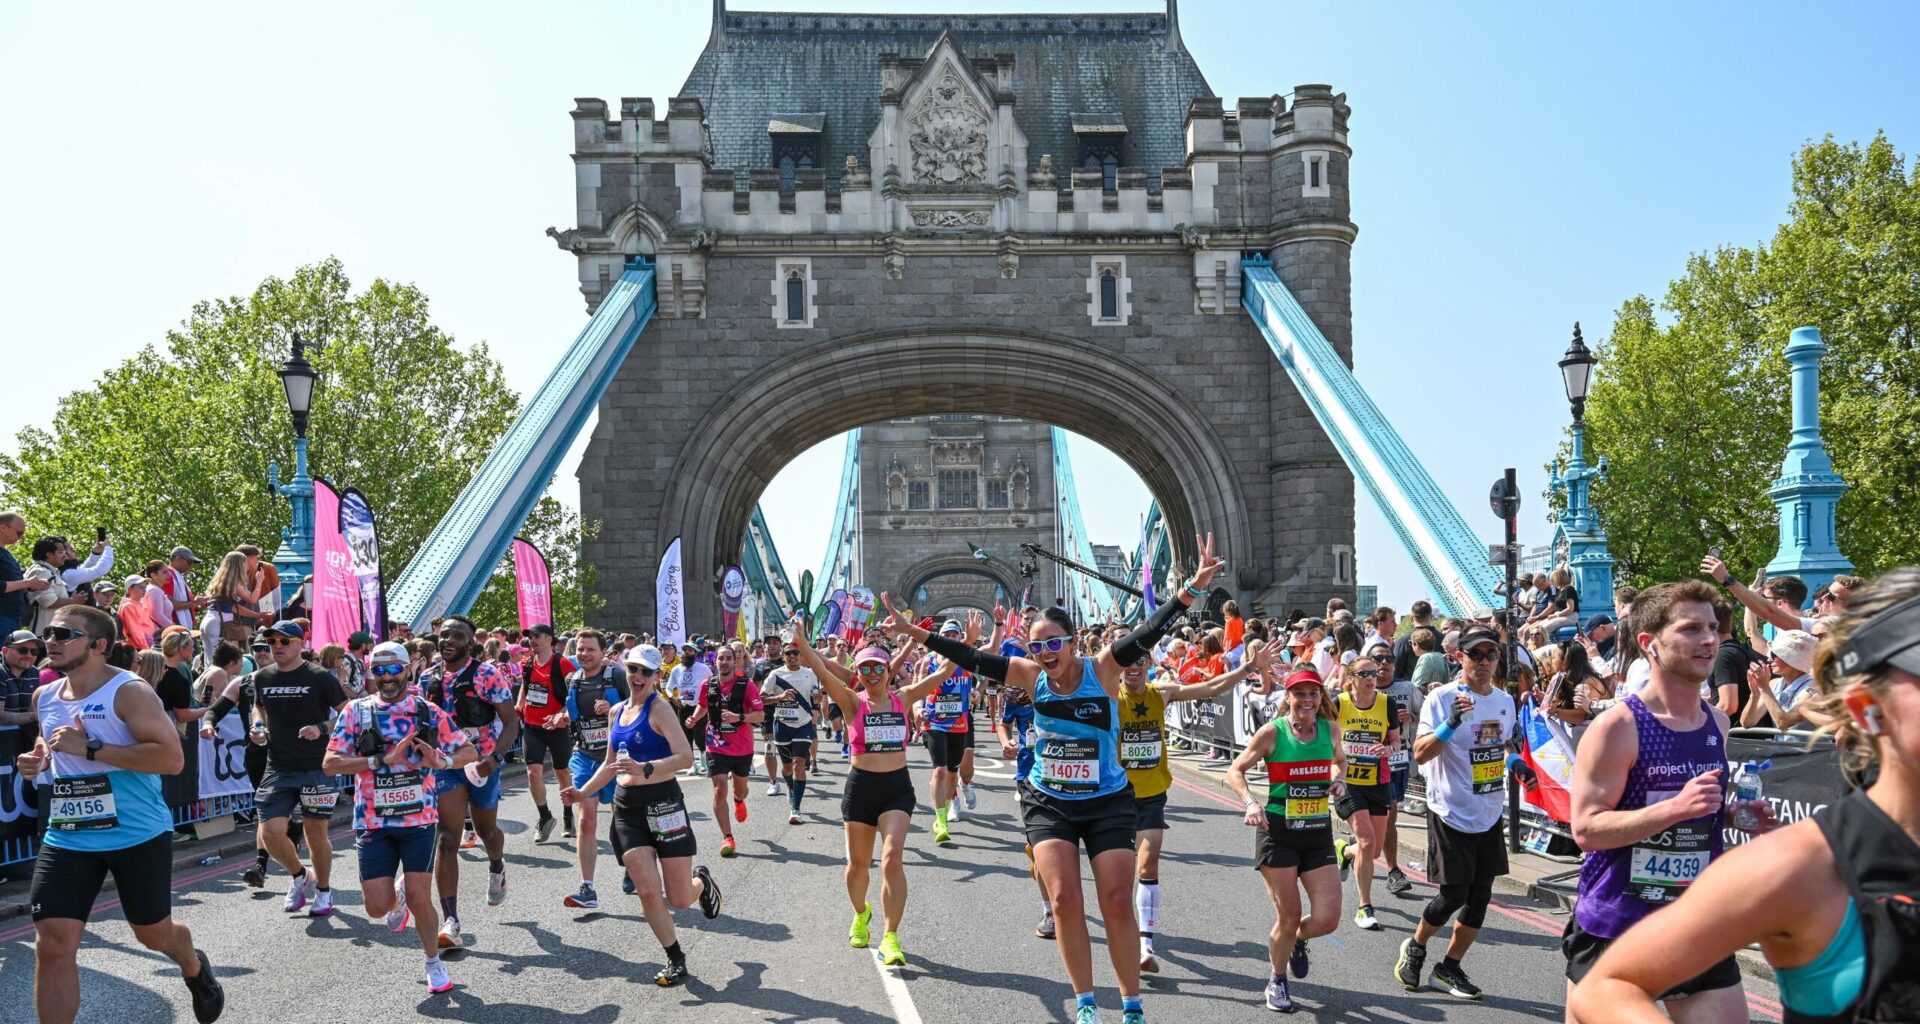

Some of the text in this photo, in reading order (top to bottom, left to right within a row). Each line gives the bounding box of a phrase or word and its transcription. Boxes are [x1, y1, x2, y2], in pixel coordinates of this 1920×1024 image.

[664, 564, 681, 632] Elsie's Story
[941, 676, 969, 687] OUTH
[262, 686, 311, 695] TREK
[865, 714, 881, 725] tcs
[1346, 718, 1383, 728] ABINGDON
[871, 729, 901, 740] 39153
[1124, 731, 1140, 742] tcs
[1043, 742, 1064, 757] tcs
[1128, 746, 1157, 757] 80261
[1472, 751, 1491, 762] tcs
[1050, 763, 1090, 779] 14075
[1289, 765, 1329, 776] MELISSA
[1346, 767, 1371, 779] LIZ
[1483, 764, 1504, 779] 7507
[1647, 764, 1687, 778] project
[376, 776, 393, 787] tcs
[53, 782, 72, 795] tcs
[1289, 785, 1308, 797] tcs
[308, 796, 335, 804] 13856
[382, 789, 416, 804] 15565
[60, 799, 104, 817] 49156
[1641, 831, 1672, 847] cs
[1675, 833, 1709, 841] CONSULTANCY
[1644, 855, 1700, 878] 44359
